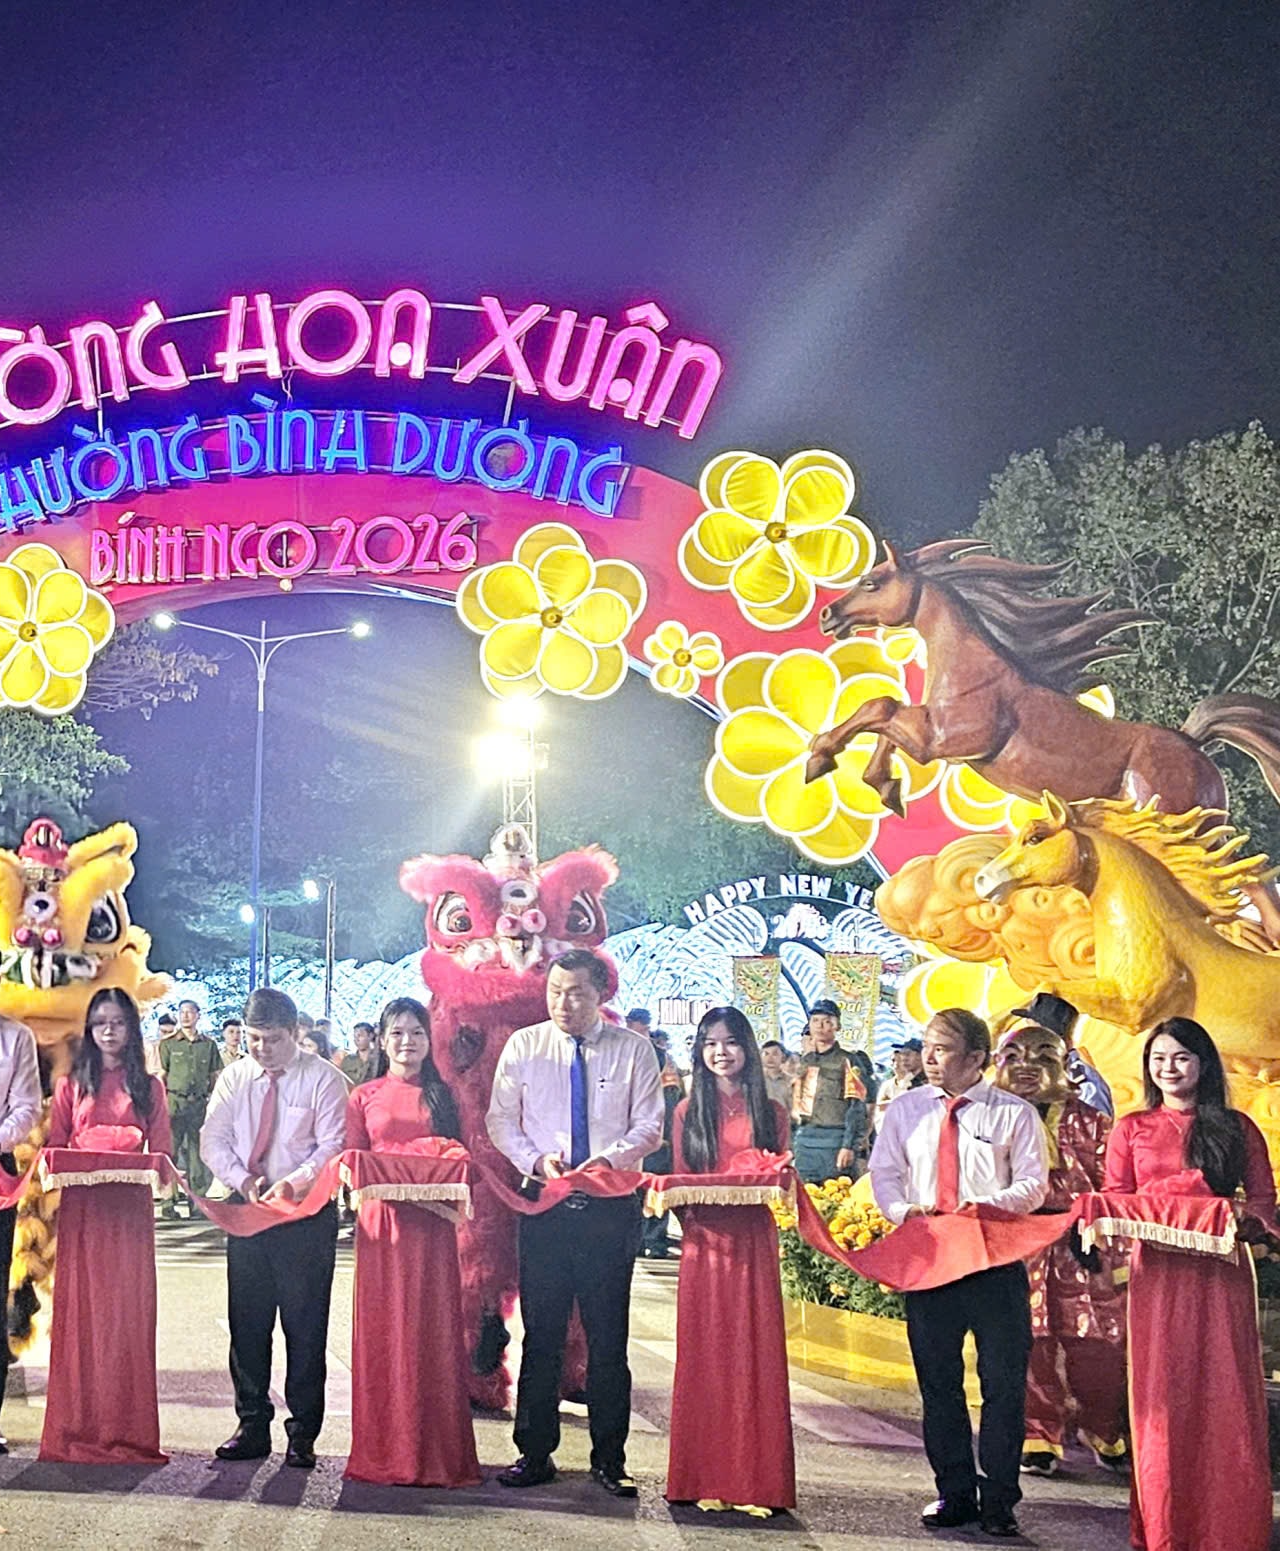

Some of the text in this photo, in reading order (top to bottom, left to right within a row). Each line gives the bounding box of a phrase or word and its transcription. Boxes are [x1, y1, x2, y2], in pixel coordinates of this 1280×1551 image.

[215, 290, 431, 383] HOA
[452, 296, 721, 439] XUÂN
[227, 393, 369, 475] BÌNH
[391, 411, 623, 517] DƯƠNG
[90, 511, 186, 585] BÍNH
[328, 512, 478, 575] 2026
[684, 876, 768, 926] HAPPY
[779, 874, 832, 898] NEW
